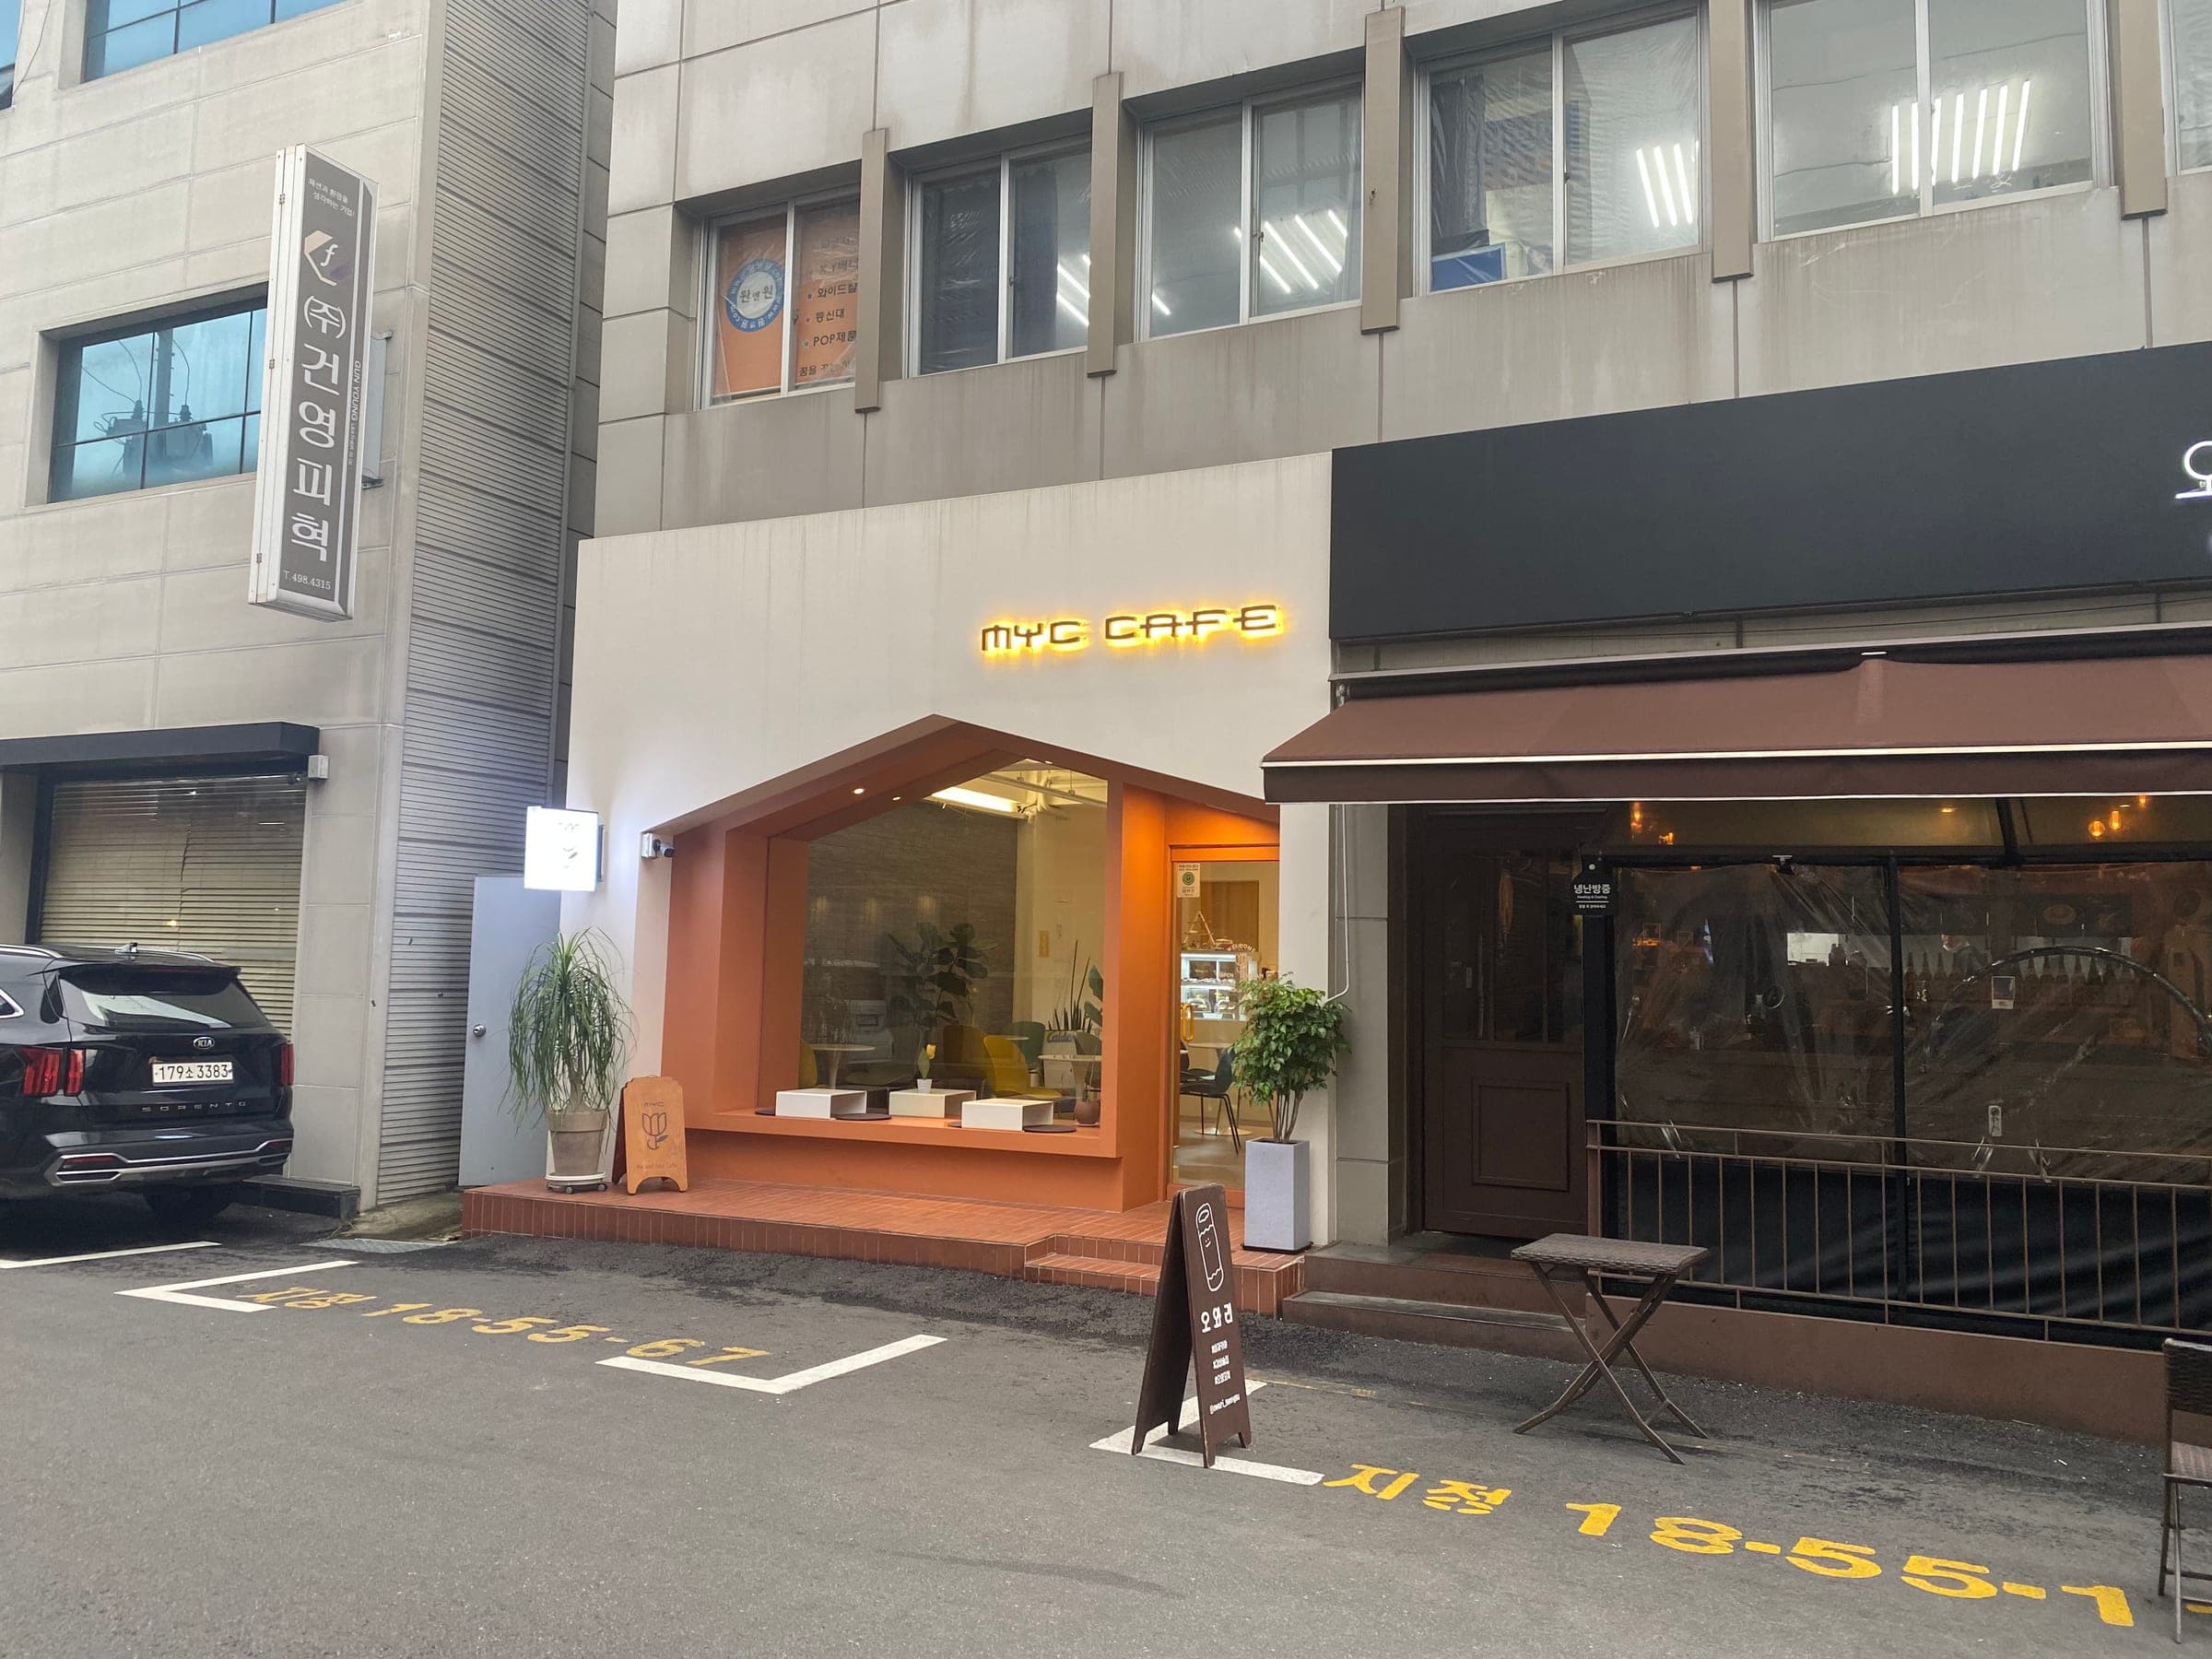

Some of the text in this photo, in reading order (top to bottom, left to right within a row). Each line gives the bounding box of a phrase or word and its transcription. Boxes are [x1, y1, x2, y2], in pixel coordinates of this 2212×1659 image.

[350, 385, 360, 421] YOUNG
[981, 605, 1277, 651] MYC CAFE
[1573, 884, 1611, 894] 냉난방중
[197, 1040, 213, 1048] KIA
[141, 1101, 246, 1112] SORENTO
[1323, 1464, 2135, 1628] 지정 18-55-1
